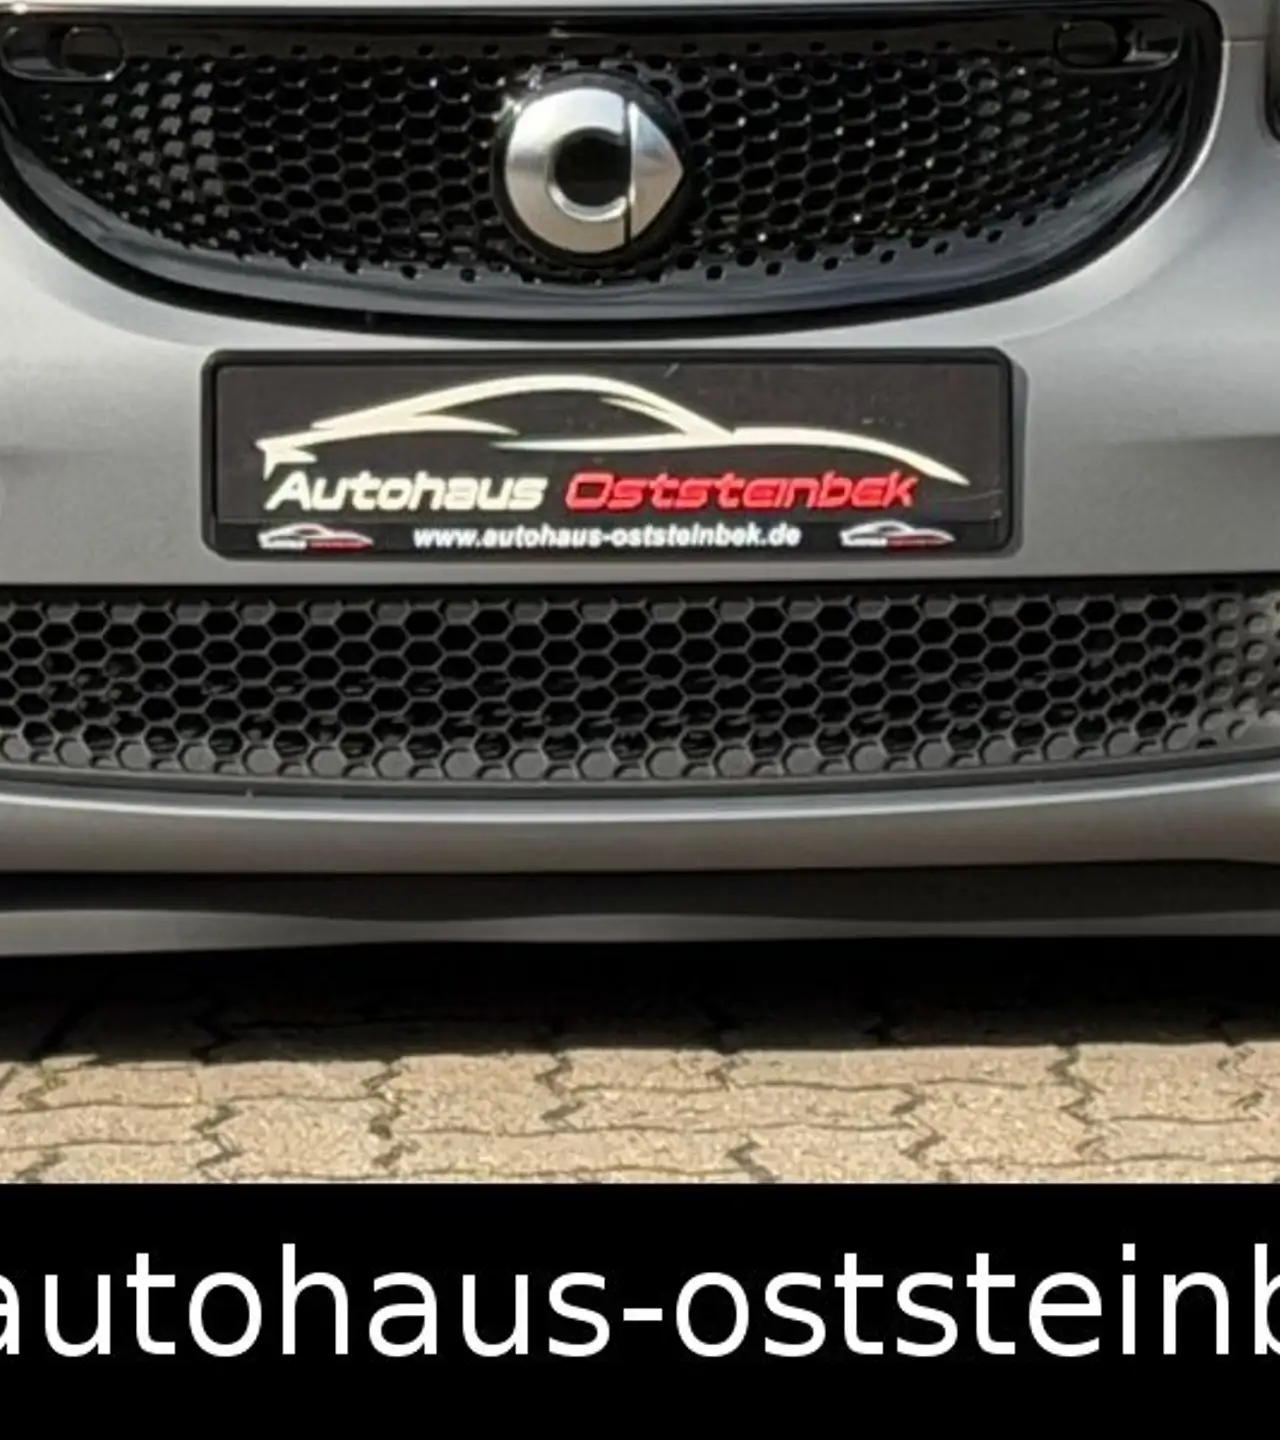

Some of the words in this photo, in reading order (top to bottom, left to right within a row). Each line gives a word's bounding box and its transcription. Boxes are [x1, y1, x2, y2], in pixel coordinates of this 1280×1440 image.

[264, 471, 548, 511] Autohaus
[565, 471, 919, 511] Oststeinbek
[412, 521, 802, 550] www.autohaus-oststeinbek.de
